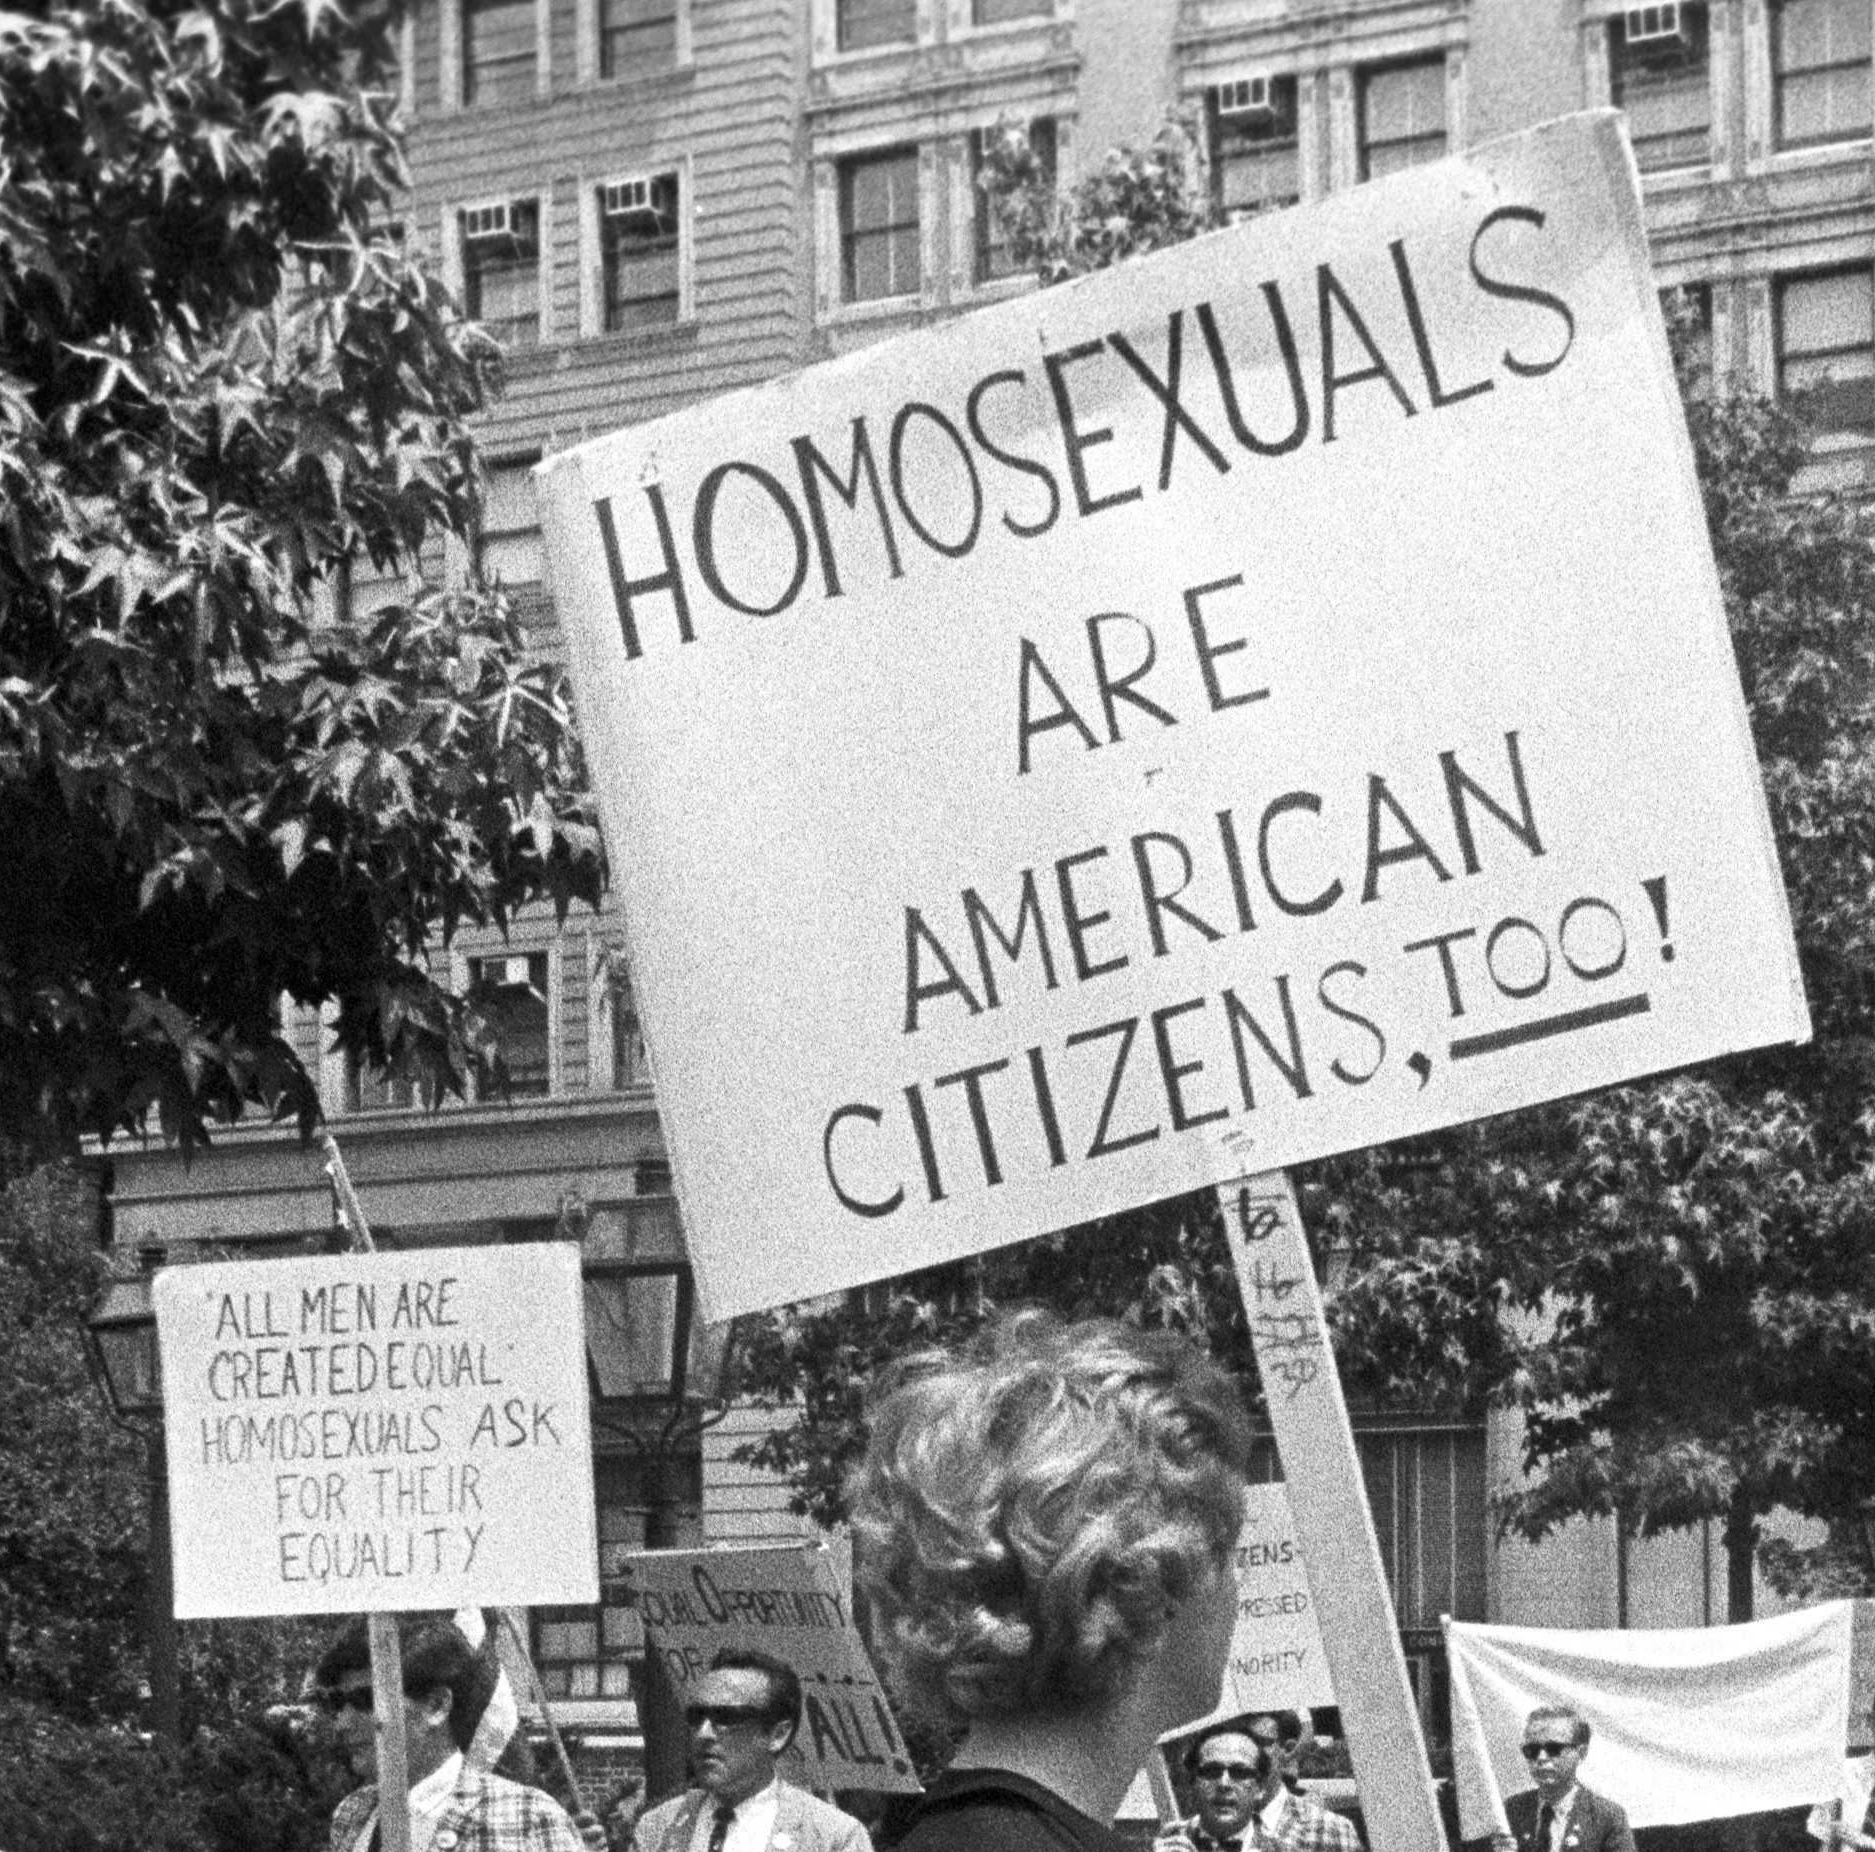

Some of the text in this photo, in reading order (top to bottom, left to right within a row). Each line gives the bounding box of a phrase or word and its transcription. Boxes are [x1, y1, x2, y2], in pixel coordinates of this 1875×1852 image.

[594, 205, 1574, 660] HOMOSEXUALS
[1017, 573, 1270, 776] ARE
[900, 731, 1547, 1032] AMERICAN
[822, 876, 1678, 1218] CITIZENS, TOO!
[301, 1283, 375, 1334] MEN
[392, 1278, 459, 1329] ARE
[208, 1342, 378, 1401] CREATED
[200, 1398, 562, 1464] HOMOSEXUALS ASK
[275, 1463, 483, 1523] FOR THEIR
[279, 1522, 484, 1585] EQUALITY
[1231, 1649, 1308, 1676] NORITY
[805, 1693, 910, 1776] ALL!
